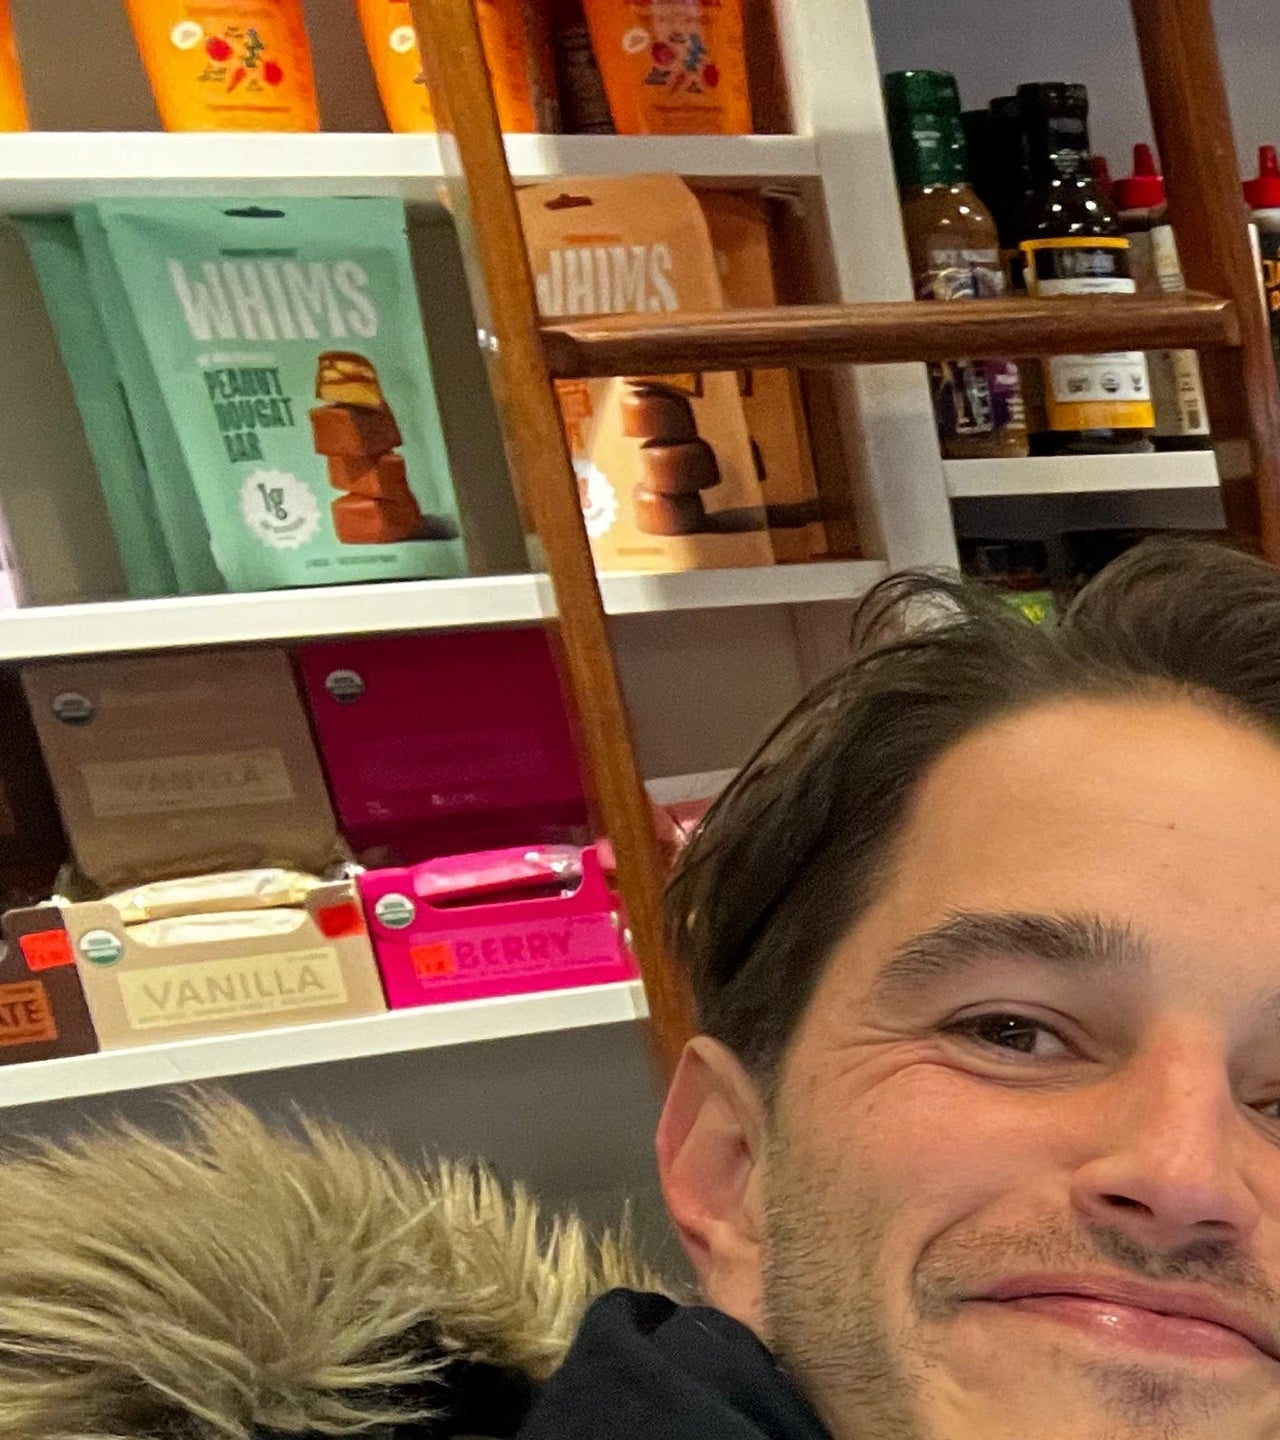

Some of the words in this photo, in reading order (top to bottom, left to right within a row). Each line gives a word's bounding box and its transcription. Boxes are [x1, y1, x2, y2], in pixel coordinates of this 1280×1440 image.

[166, 257, 378, 341] WHIMS
[203, 366, 285, 401] PEANUT
[213, 396, 296, 433] NOUGAT
[223, 431, 264, 464] BAR
[455, 931, 573, 970] BERRY
[141, 963, 328, 1012] VANILLA
